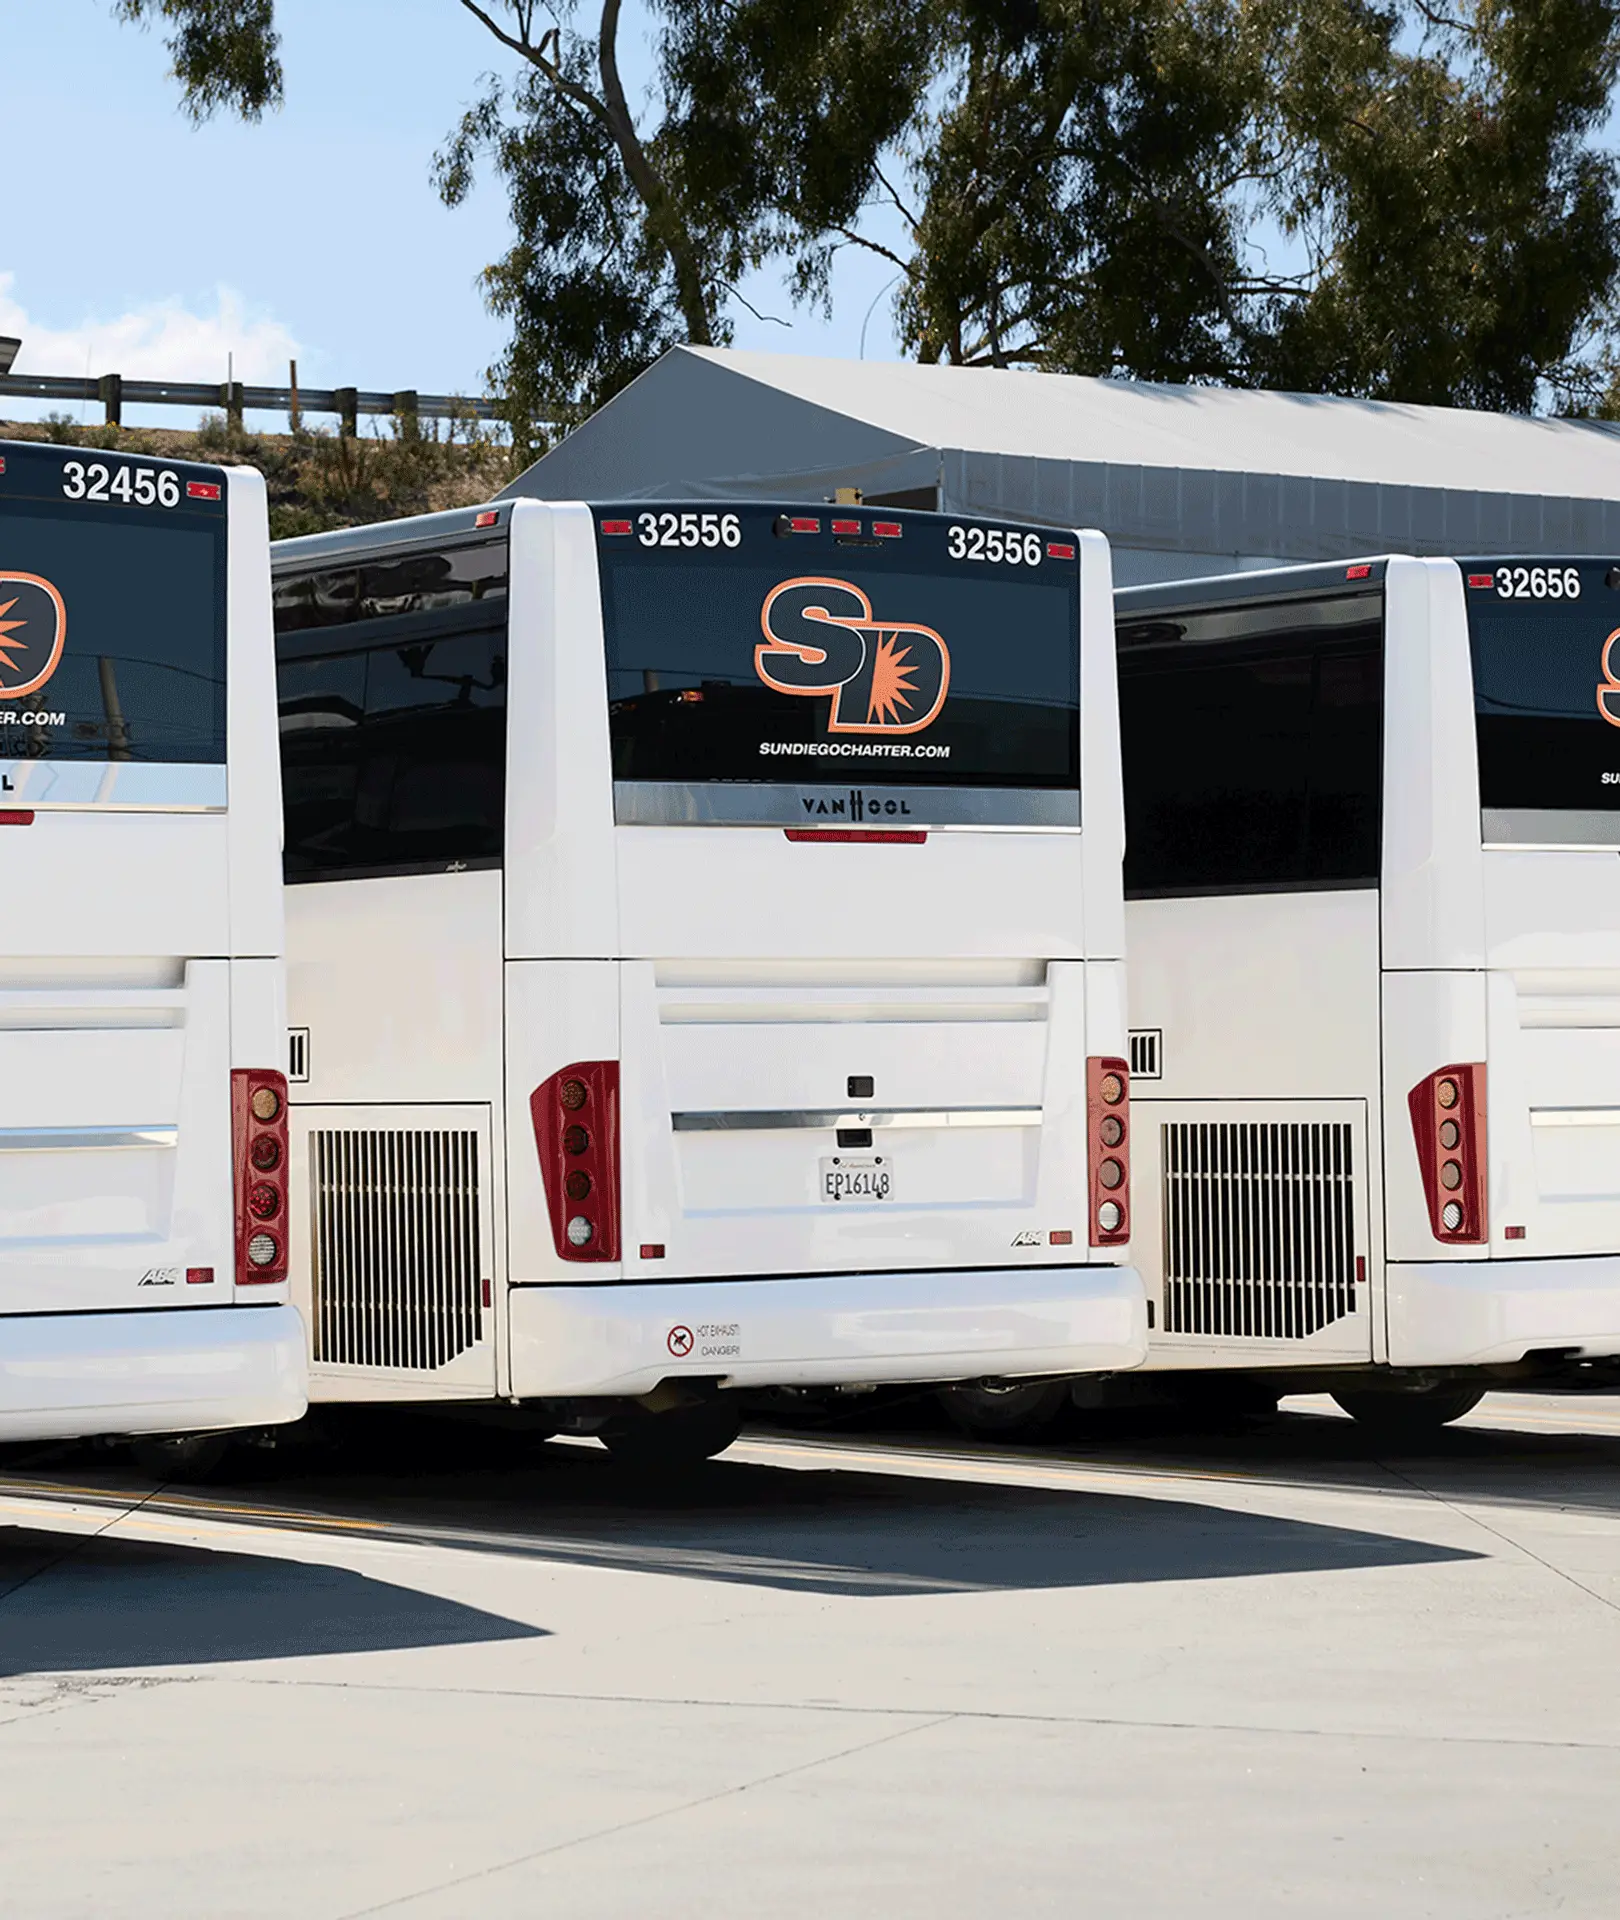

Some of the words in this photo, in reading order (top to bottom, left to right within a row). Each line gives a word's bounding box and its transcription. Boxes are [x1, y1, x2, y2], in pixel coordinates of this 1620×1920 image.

[63, 461, 180, 508] 32456
[638, 512, 741, 548] 32556
[948, 526, 1041, 566] 32556
[1496, 567, 1580, 599] 32656
[759, 742, 950, 758] SUNDIEGOCHARTER.COM
[826, 1173, 889, 1194] EP16148
